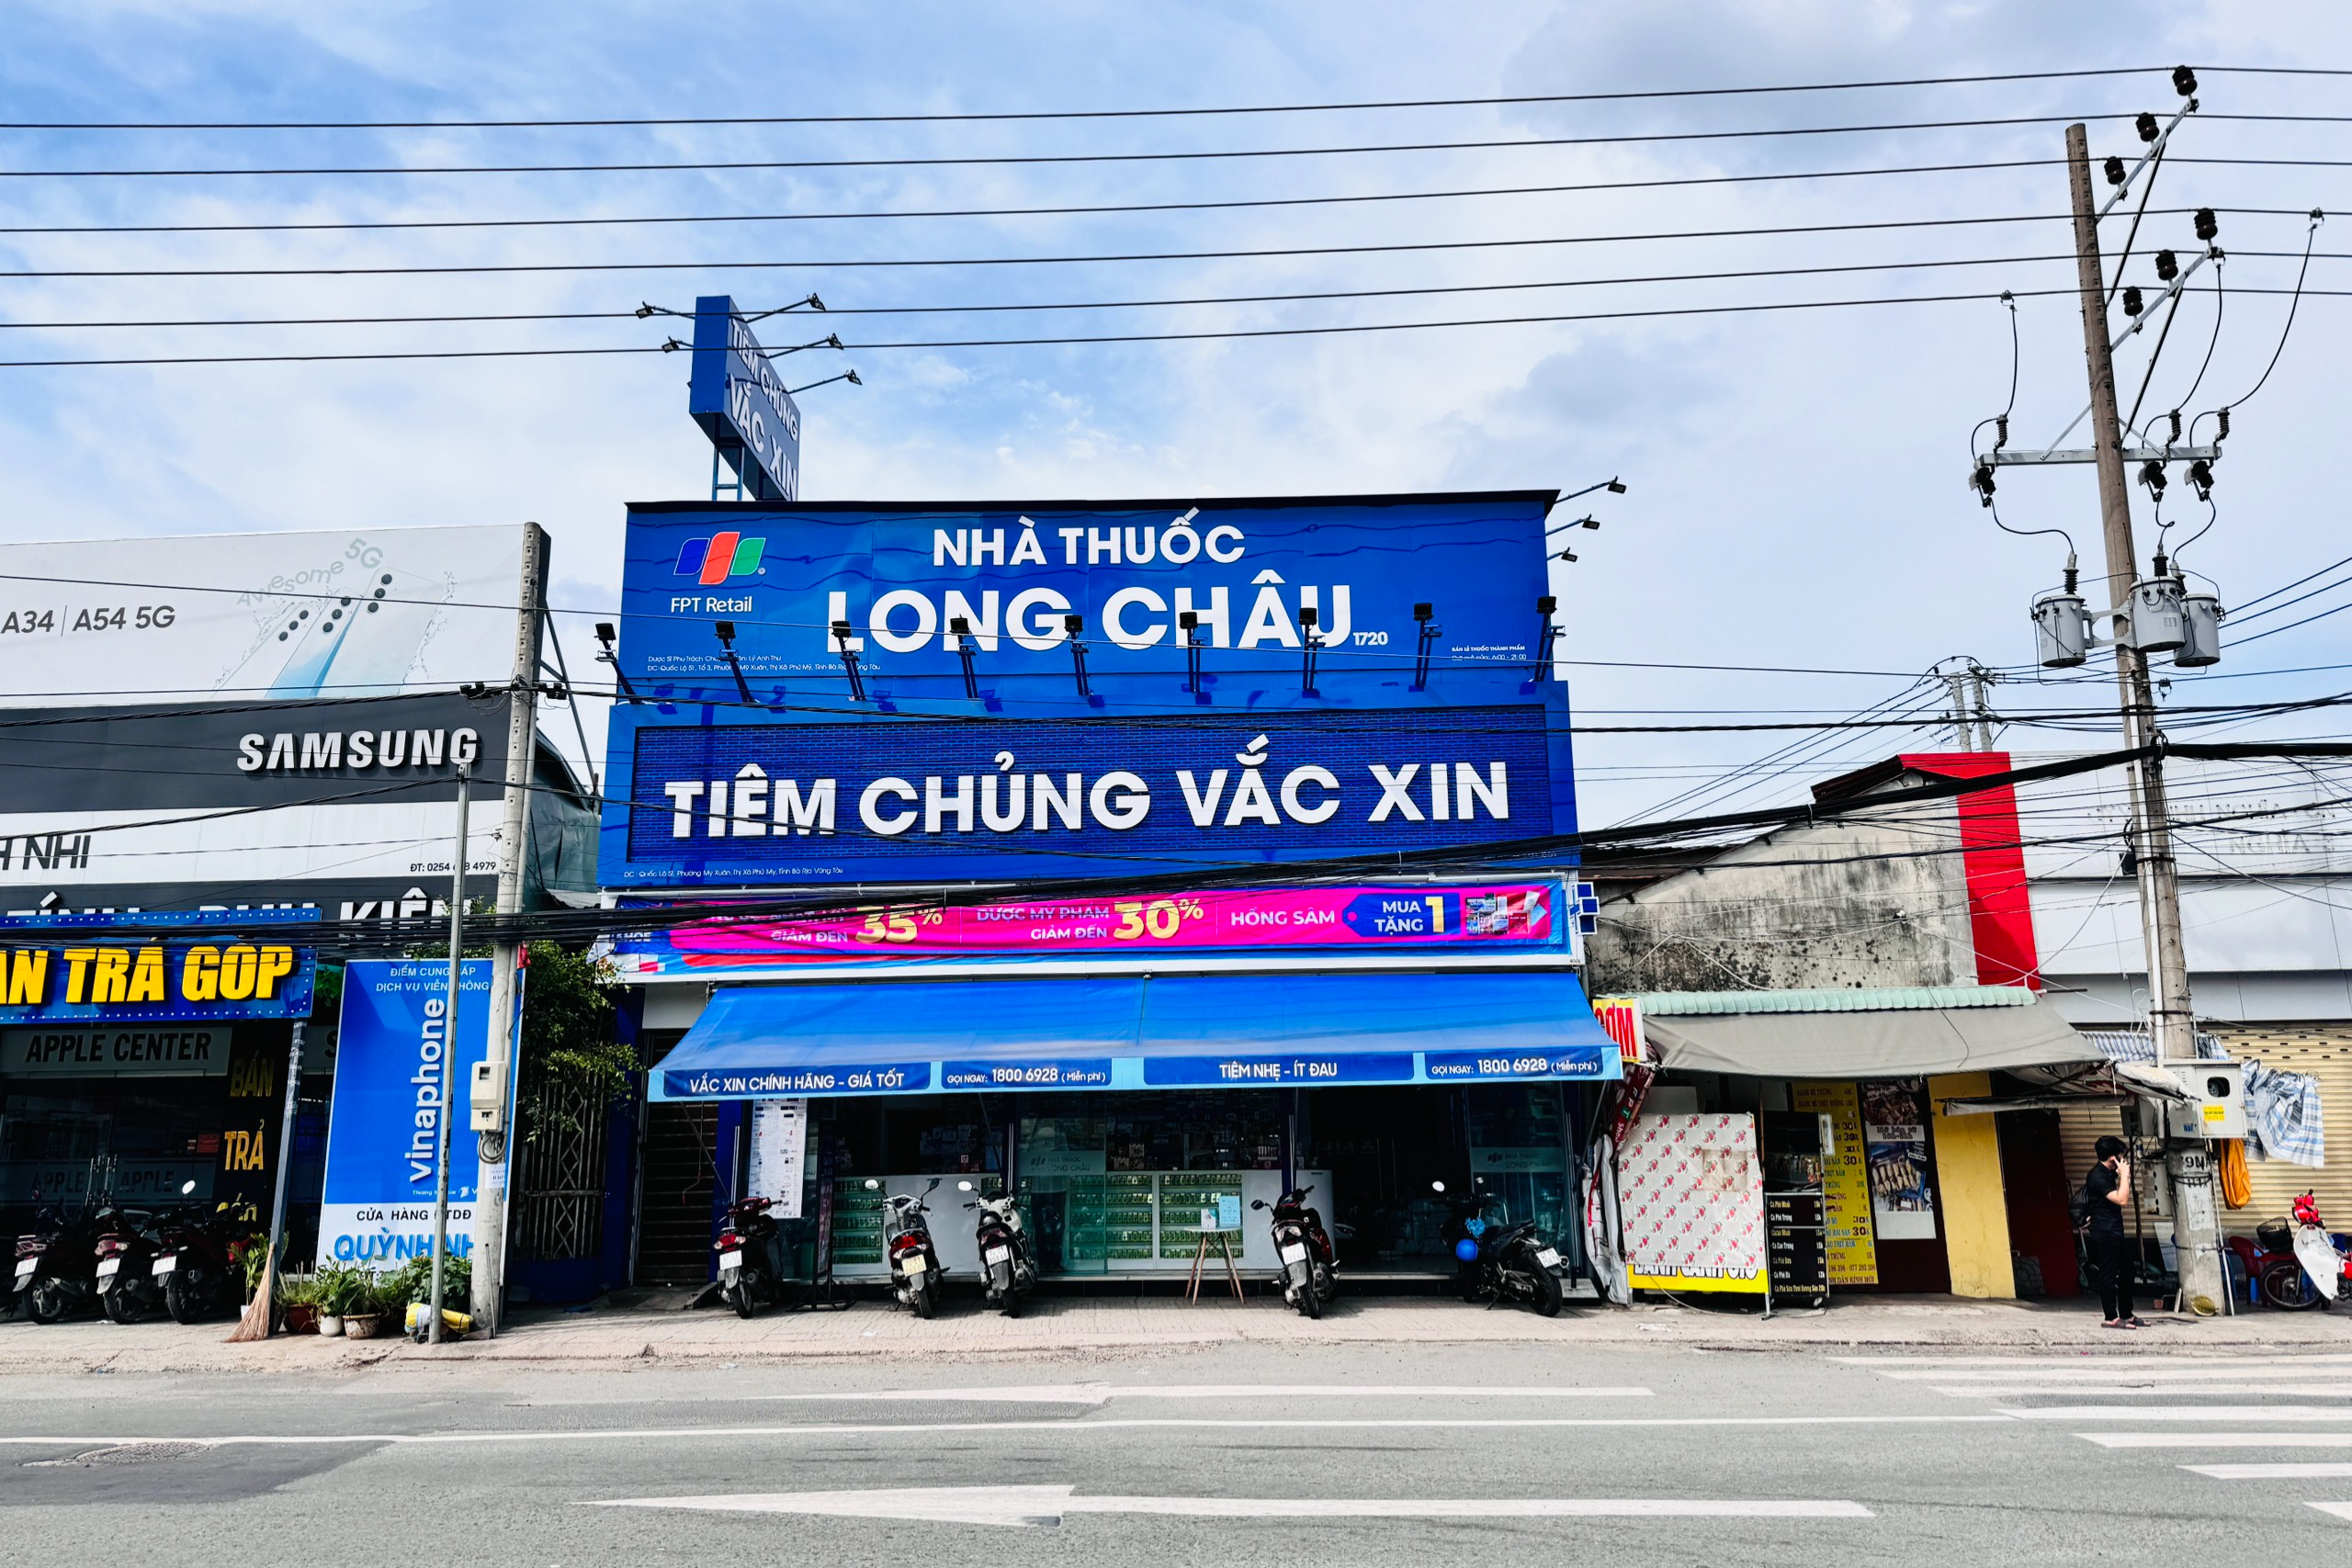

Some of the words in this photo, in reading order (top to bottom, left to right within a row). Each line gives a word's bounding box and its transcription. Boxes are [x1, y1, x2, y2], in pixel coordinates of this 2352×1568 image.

[732, 320, 759, 383] TIÊM
[760, 367, 797, 442] CHỦNG
[729, 373, 764, 454] VẮC
[770, 434, 797, 502] XIN
[933, 515, 1047, 567] NHÀ
[1057, 506, 1246, 566] THUỐC
[237, 561, 344, 607] Awesome
[345, 537, 383, 569] 5G
[1, 610, 54, 634] A34
[73, 607, 127, 631] A54
[134, 604, 175, 628] 5G
[670, 597, 701, 613] FPT
[706, 595, 752, 613] Retail
[827, 587, 1072, 653] LONG
[1102, 569, 1352, 650] CHÂU
[1353, 631, 1388, 647] 1720
[237, 727, 478, 771] SAMSUNG
[663, 762, 837, 839] TIÊM
[858, 750, 1151, 836] CHỦNG
[1175, 733, 1340, 827] VẮC
[1367, 761, 1509, 822] XIN
[25, 834, 91, 871] NHI
[411, 863, 425, 872] ĐT:
[427, 863, 450, 872] 0254
[473, 862, 497, 871] 4979
[1031, 923, 1072, 941] GIẢM
[1074, 923, 1108, 940] ĐẾN
[1113, 897, 1204, 941] 30%
[1230, 905, 1289, 927] HỒNG
[1293, 907, 1336, 925] SÂM
[1374, 917, 1424, 936] TẶNG
[1382, 900, 1421, 914] MUA
[1425, 896, 1444, 933] 1
[376, 982, 401, 994] DỊCH
[405, 982, 420, 994] VỤ
[424, 979, 448, 991] VIỄN
[458, 979, 490, 991] HÔNG
[390, 964, 416, 976] ĐIỂM
[420, 966, 450, 976] CUNG
[459, 963, 476, 976] ẤP
[26, 1033, 107, 1063] APPLE
[113, 1032, 212, 1062] CENTER
[230, 1049, 275, 1098] BÁN
[689, 1073, 720, 1093] VẮC
[723, 1077, 747, 1092] XIN
[749, 1073, 792, 1090] CHÍNH
[794, 1072, 835, 1090] HÃNG
[848, 1072, 873, 1089] GIÁ
[876, 1069, 905, 1089] TỐT
[946, 1074, 963, 1086] GỌI
[964, 1073, 989, 1085] NGAY:
[992, 1067, 1023, 1083] 1800
[1025, 1066, 1058, 1082] 6928
[1219, 1060, 1251, 1078] TIÊM
[1254, 1063, 1281, 1080] NHẸ
[1293, 1059, 1306, 1077] ÍT
[1309, 1062, 1338, 1077] ĐAU
[1431, 1066, 1448, 1077] GỌI
[1449, 1065, 1474, 1076] NGAY:
[1476, 1058, 1510, 1074] 1800
[1513, 1057, 1547, 1073] 6928
[404, 998, 446, 1183] vinaphone
[224, 1119, 265, 1170] TRẢ
[356, 1205, 384, 1221] CỬA
[390, 1206, 429, 1221] HÀNG
[435, 1209, 471, 1220] TDĐ
[334, 1226, 434, 1261] QUỲNH
